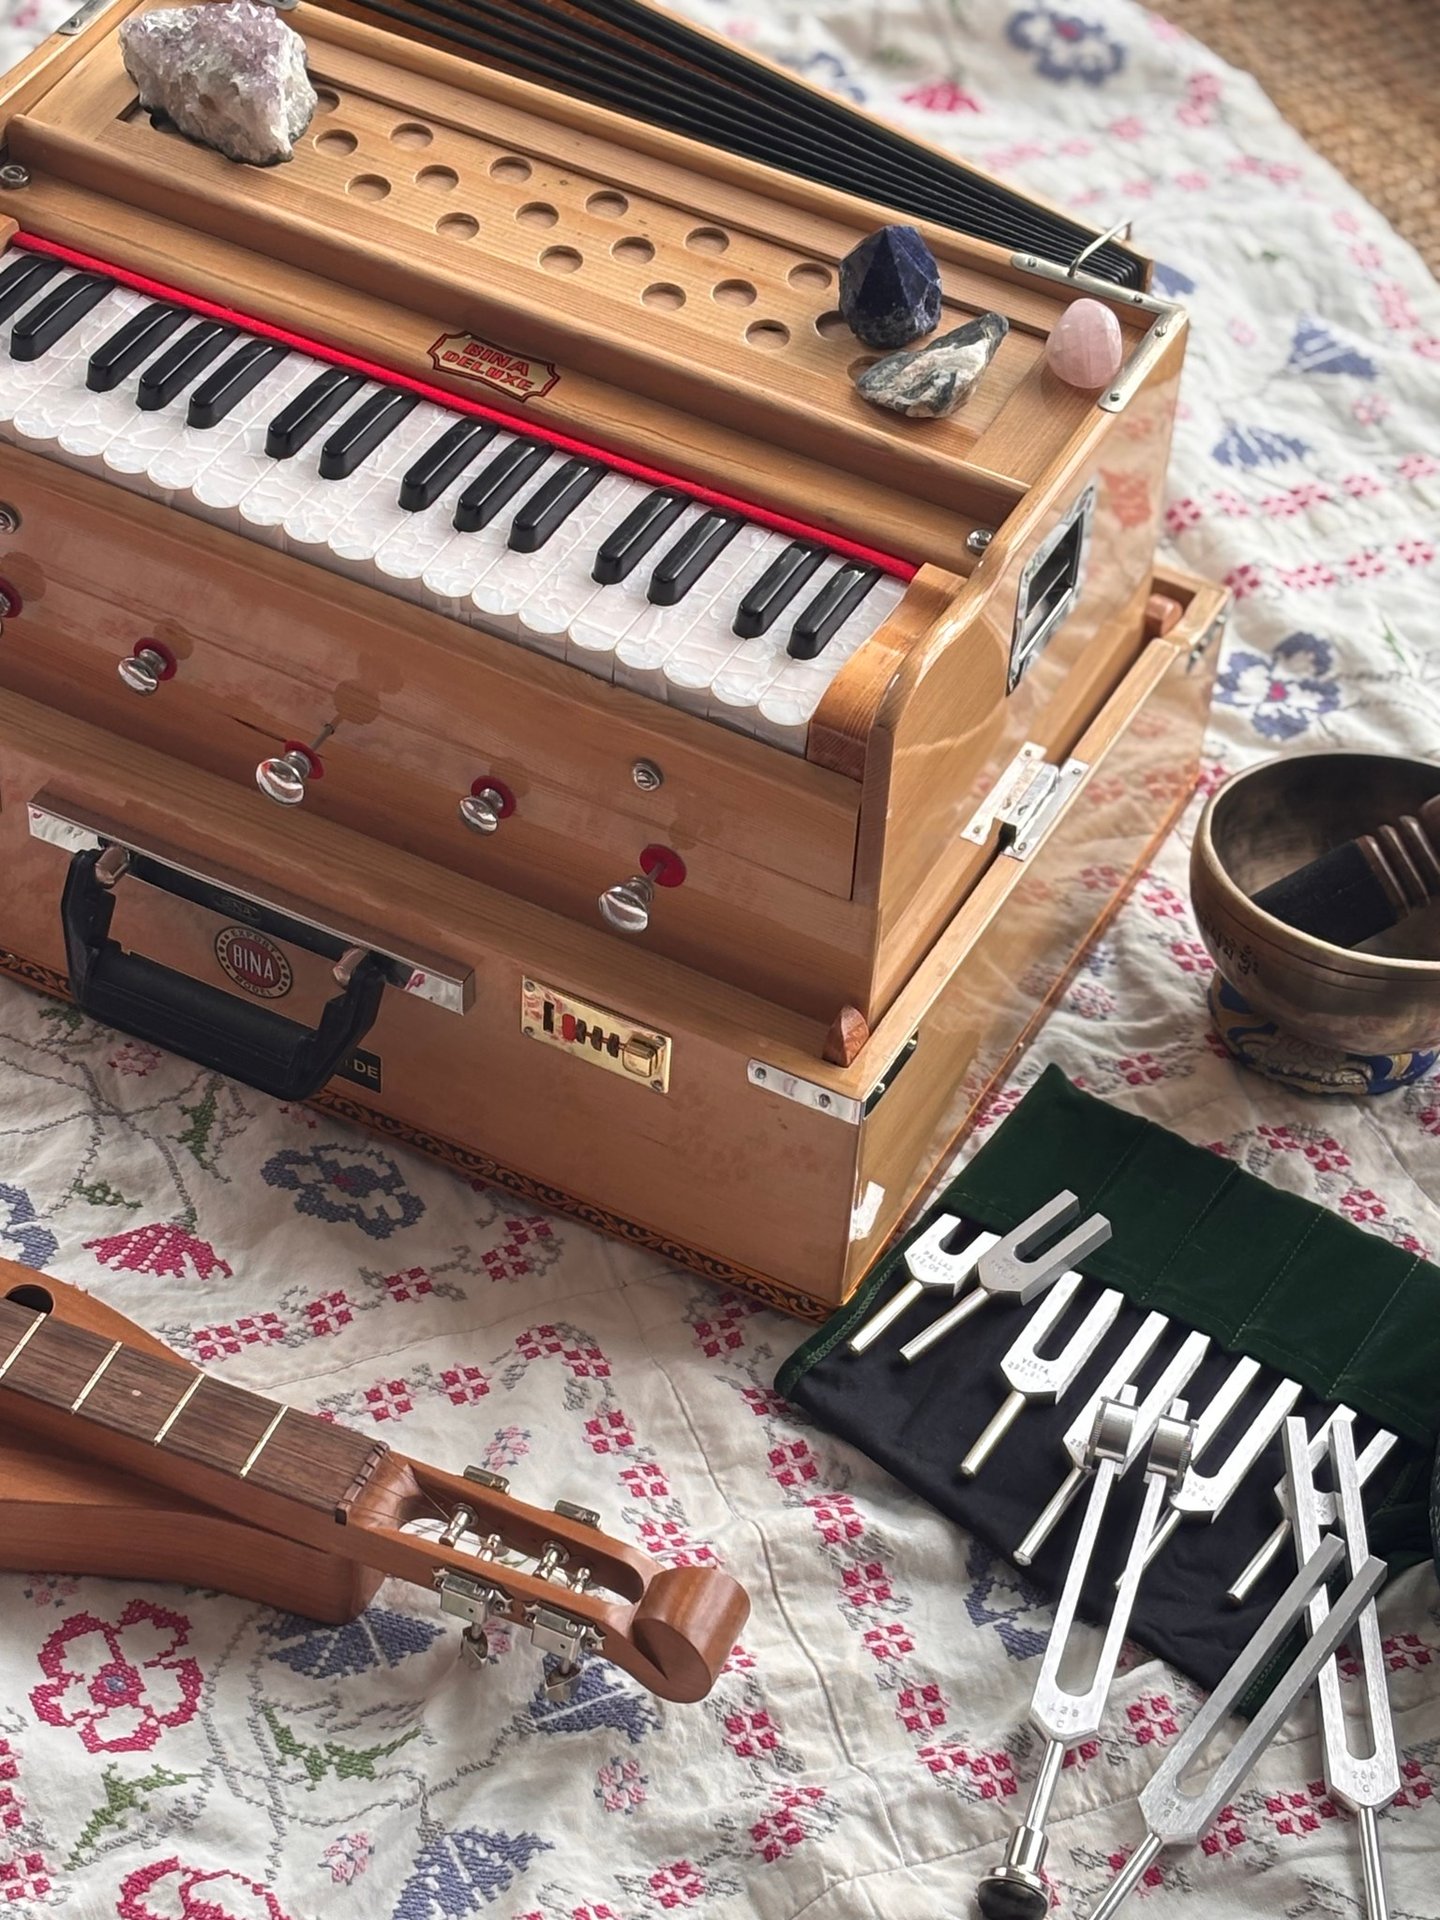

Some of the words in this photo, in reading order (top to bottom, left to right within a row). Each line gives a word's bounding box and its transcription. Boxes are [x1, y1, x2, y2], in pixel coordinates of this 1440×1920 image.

[441, 350, 535, 391] DELUXE
[463, 341, 530, 377] BINA
[233, 944, 274, 982] BINA
[1022, 1357, 1050, 1376] VESTA
[1056, 1719, 1065, 1729] C
